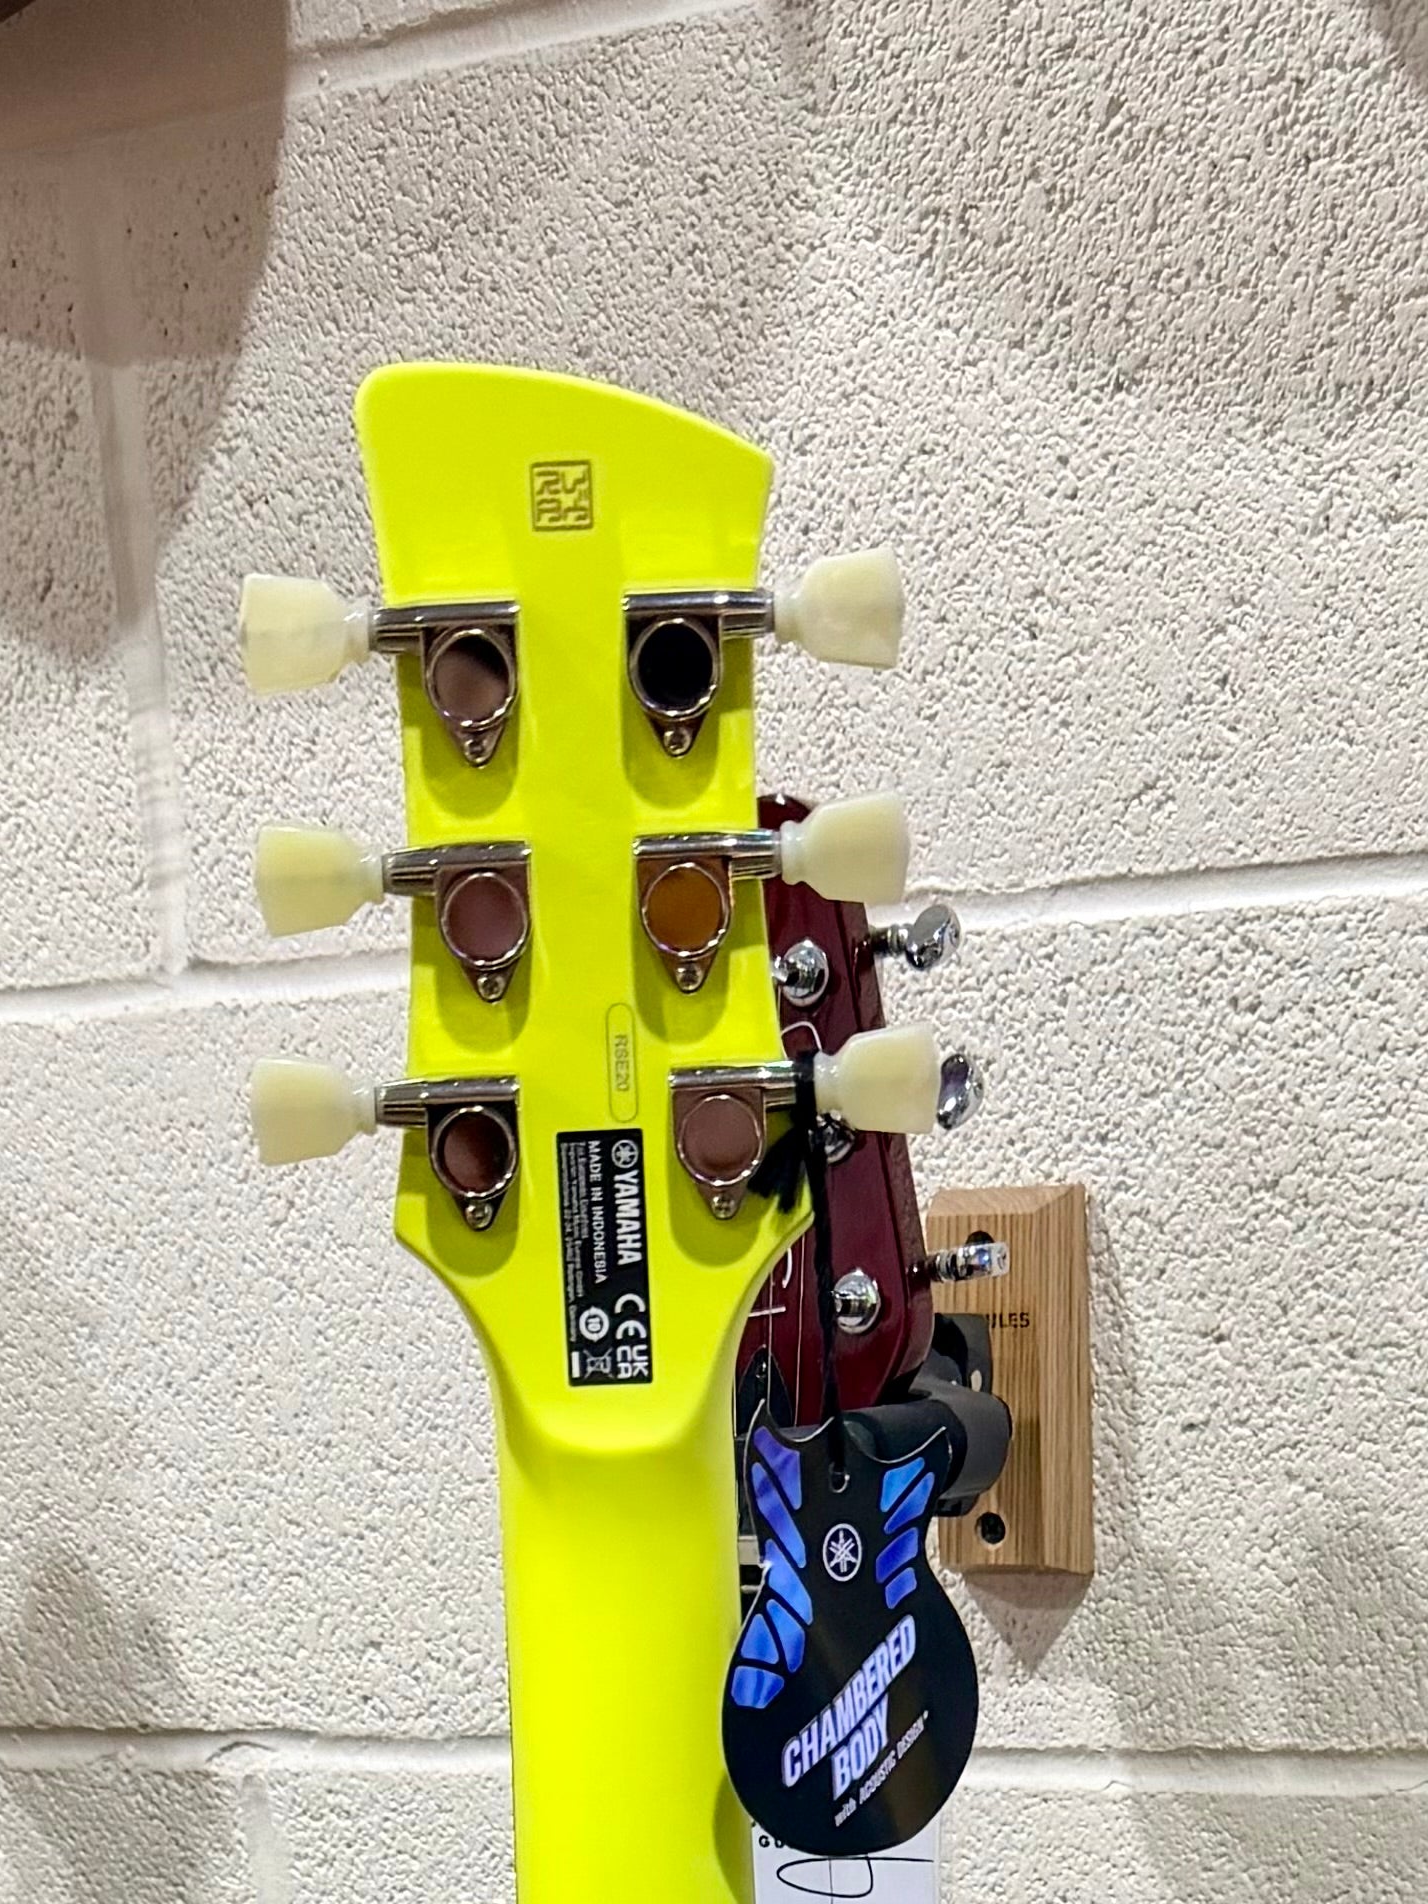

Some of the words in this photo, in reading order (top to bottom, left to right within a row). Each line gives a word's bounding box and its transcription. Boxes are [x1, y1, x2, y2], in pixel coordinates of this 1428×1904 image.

[588, 1141, 603, 1182] MADE
[590, 1187, 604, 1202] IN
[591, 1206, 608, 1284] INDONESIA
[614, 1170, 642, 1265] YAMAHA
[781, 1614, 917, 1788] CHAMBERED
[831, 1692, 889, 1801] BODY
